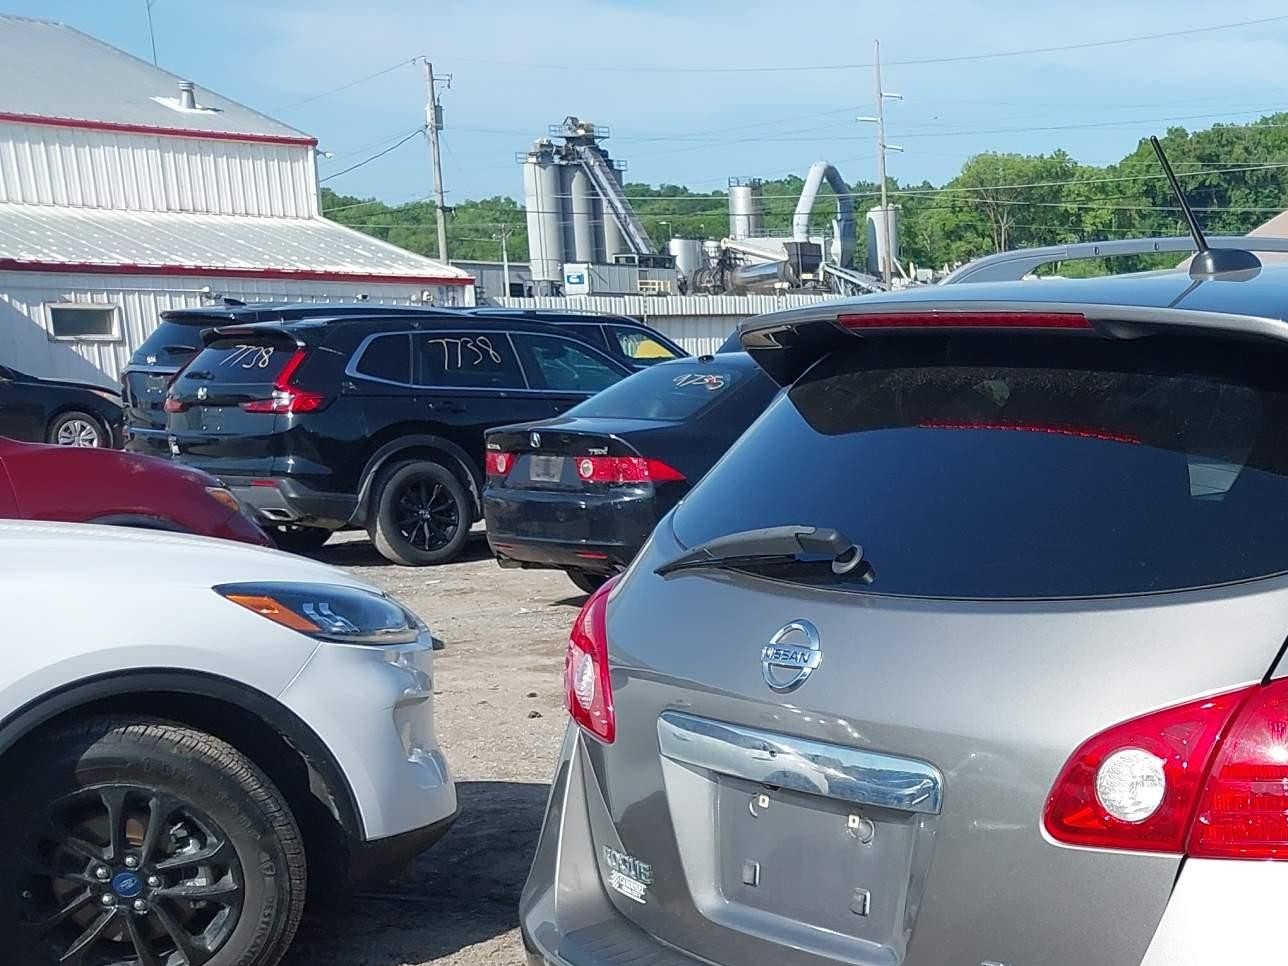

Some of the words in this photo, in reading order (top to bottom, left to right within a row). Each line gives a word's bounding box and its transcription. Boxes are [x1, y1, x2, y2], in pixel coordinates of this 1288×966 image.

[218, 344, 275, 369] 7738
[428, 336, 502, 371] 7738
[761, 645, 811, 664] NISSAN
